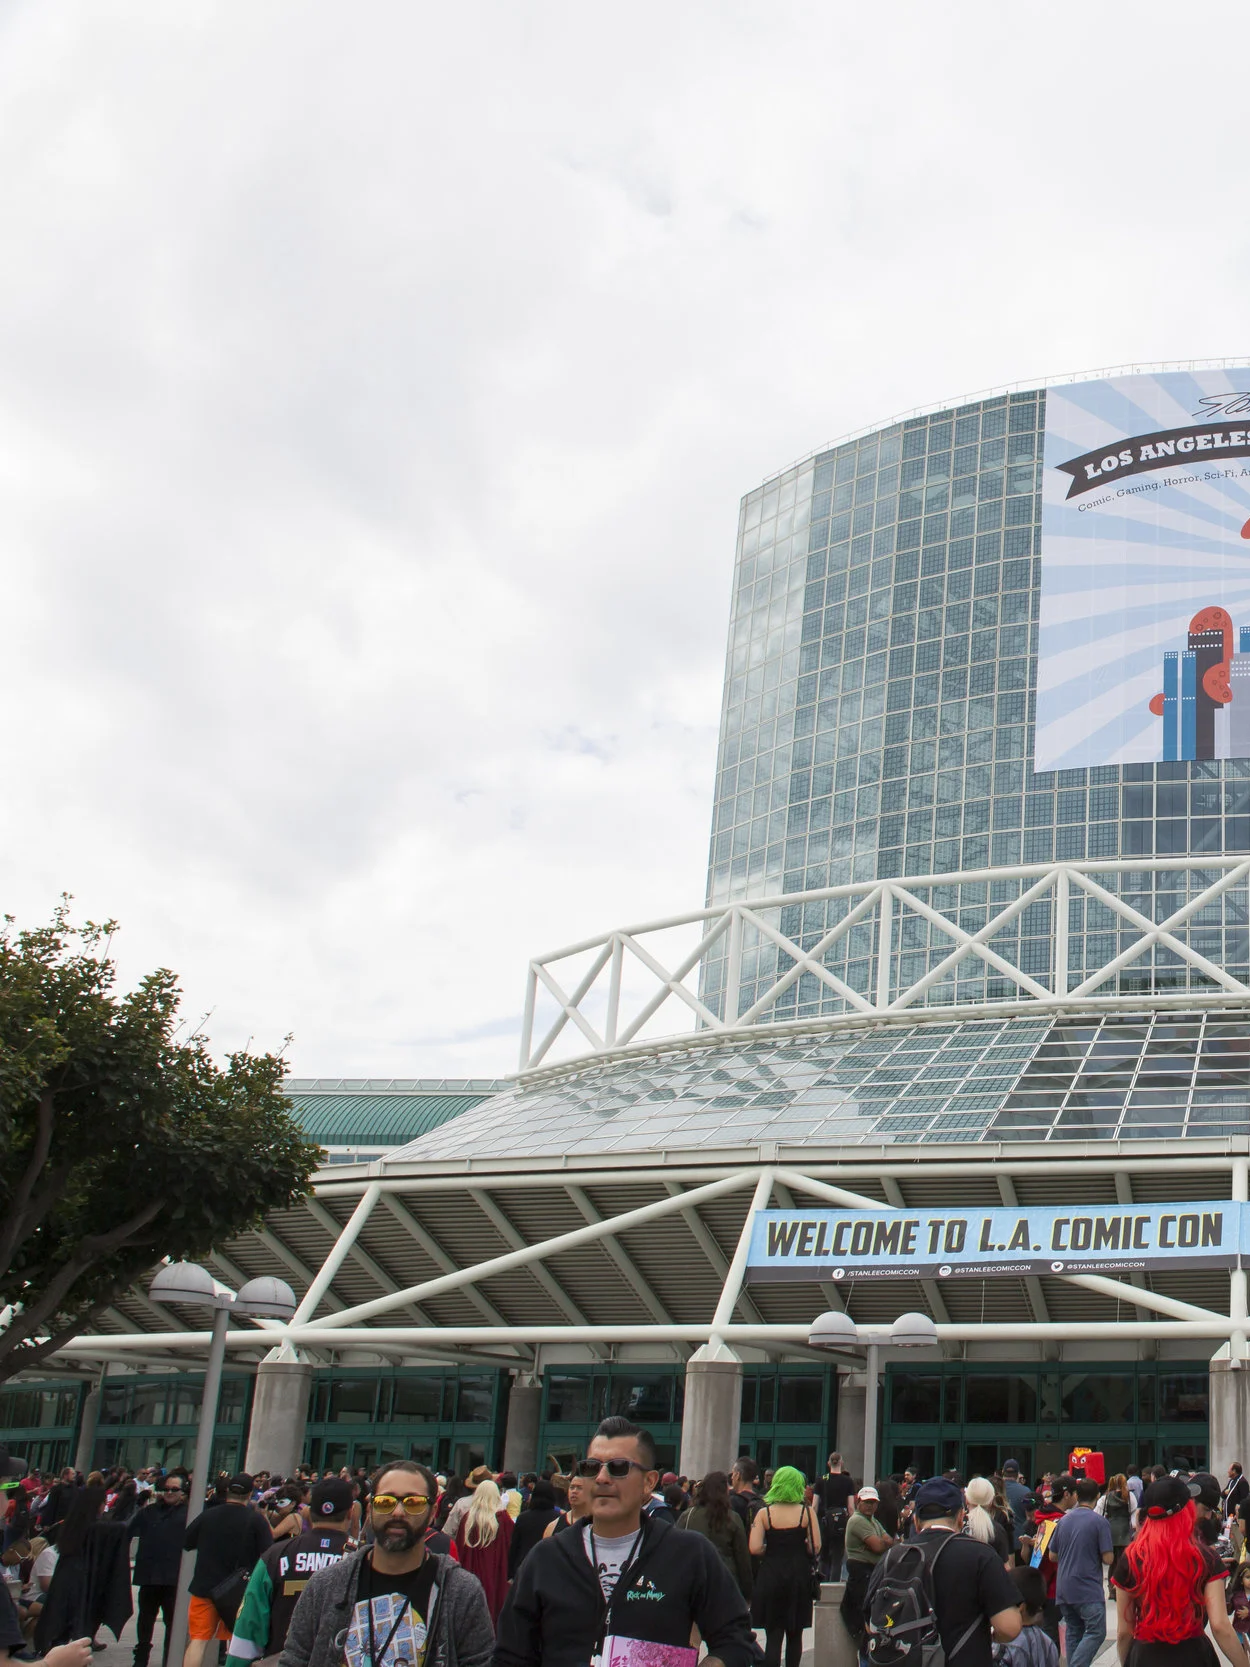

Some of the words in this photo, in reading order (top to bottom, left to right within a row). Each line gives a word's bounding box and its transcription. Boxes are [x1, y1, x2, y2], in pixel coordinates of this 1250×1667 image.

[1084, 449, 1134, 480] LOS
[1077, 495, 1115, 512] Comic,
[1116, 481, 1162, 497] Gaming,
[1164, 474, 1202, 487] Horror,
[1204, 470, 1238, 480] Sci-Fi,
[766, 1219, 920, 1257] WELCOME
[926, 1218, 968, 1255] TO
[978, 1217, 1042, 1252] L.A.
[1050, 1215, 1152, 1251] COMIC
[1158, 1212, 1223, 1248] CON
[954, 1264, 1031, 1274] @STANLEECOMICCON
[1066, 1261, 1145, 1270] @STANLEECOMICCON
